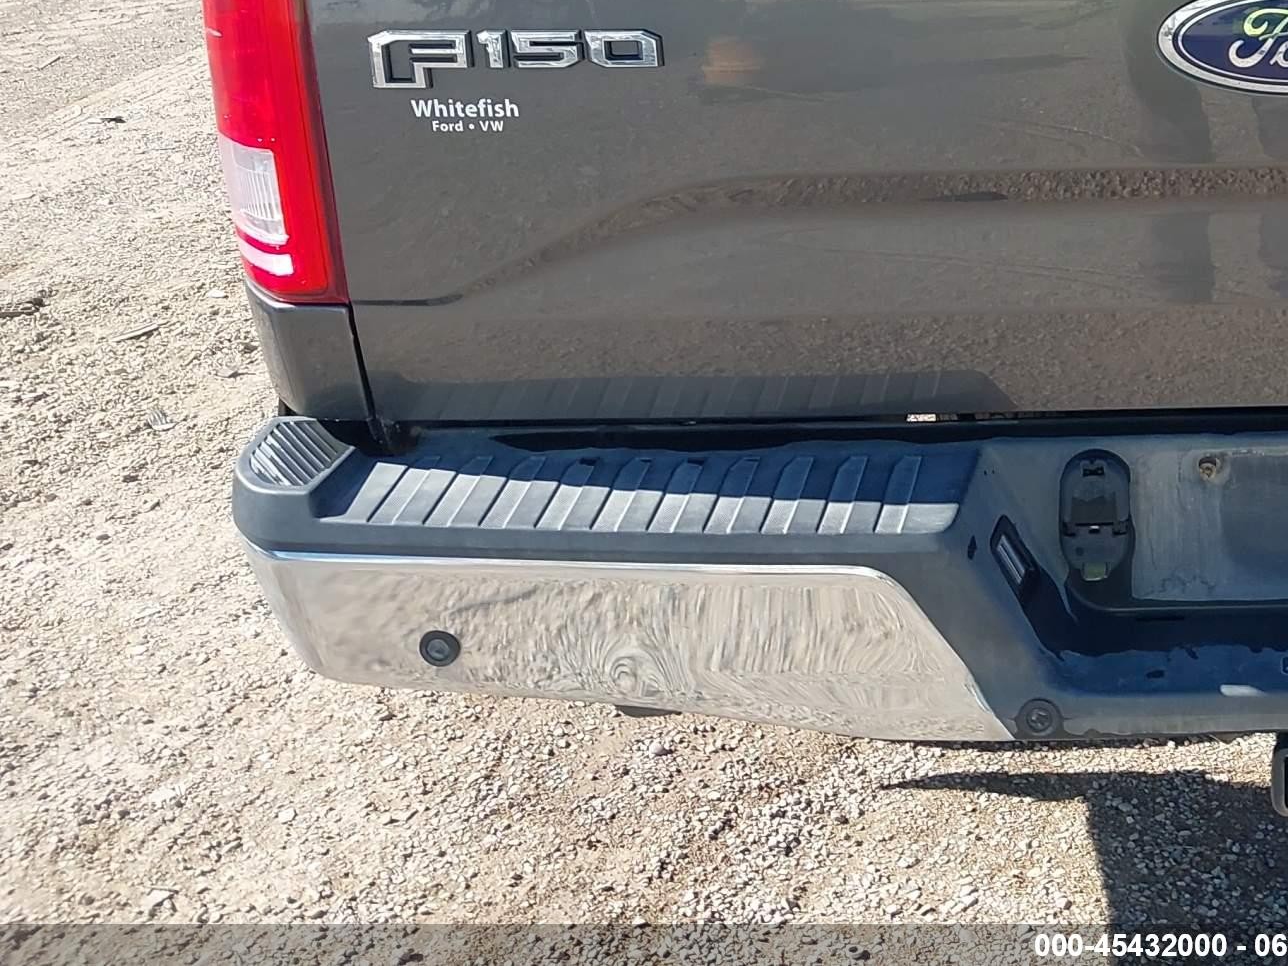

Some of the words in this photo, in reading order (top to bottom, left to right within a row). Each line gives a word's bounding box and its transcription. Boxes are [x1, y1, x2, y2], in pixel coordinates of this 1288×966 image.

[367, 28, 665, 90] F150
[410, 98, 520, 118] Whitefish
[431, 120, 464, 132] Ford
[480, 120, 504, 132] VW
